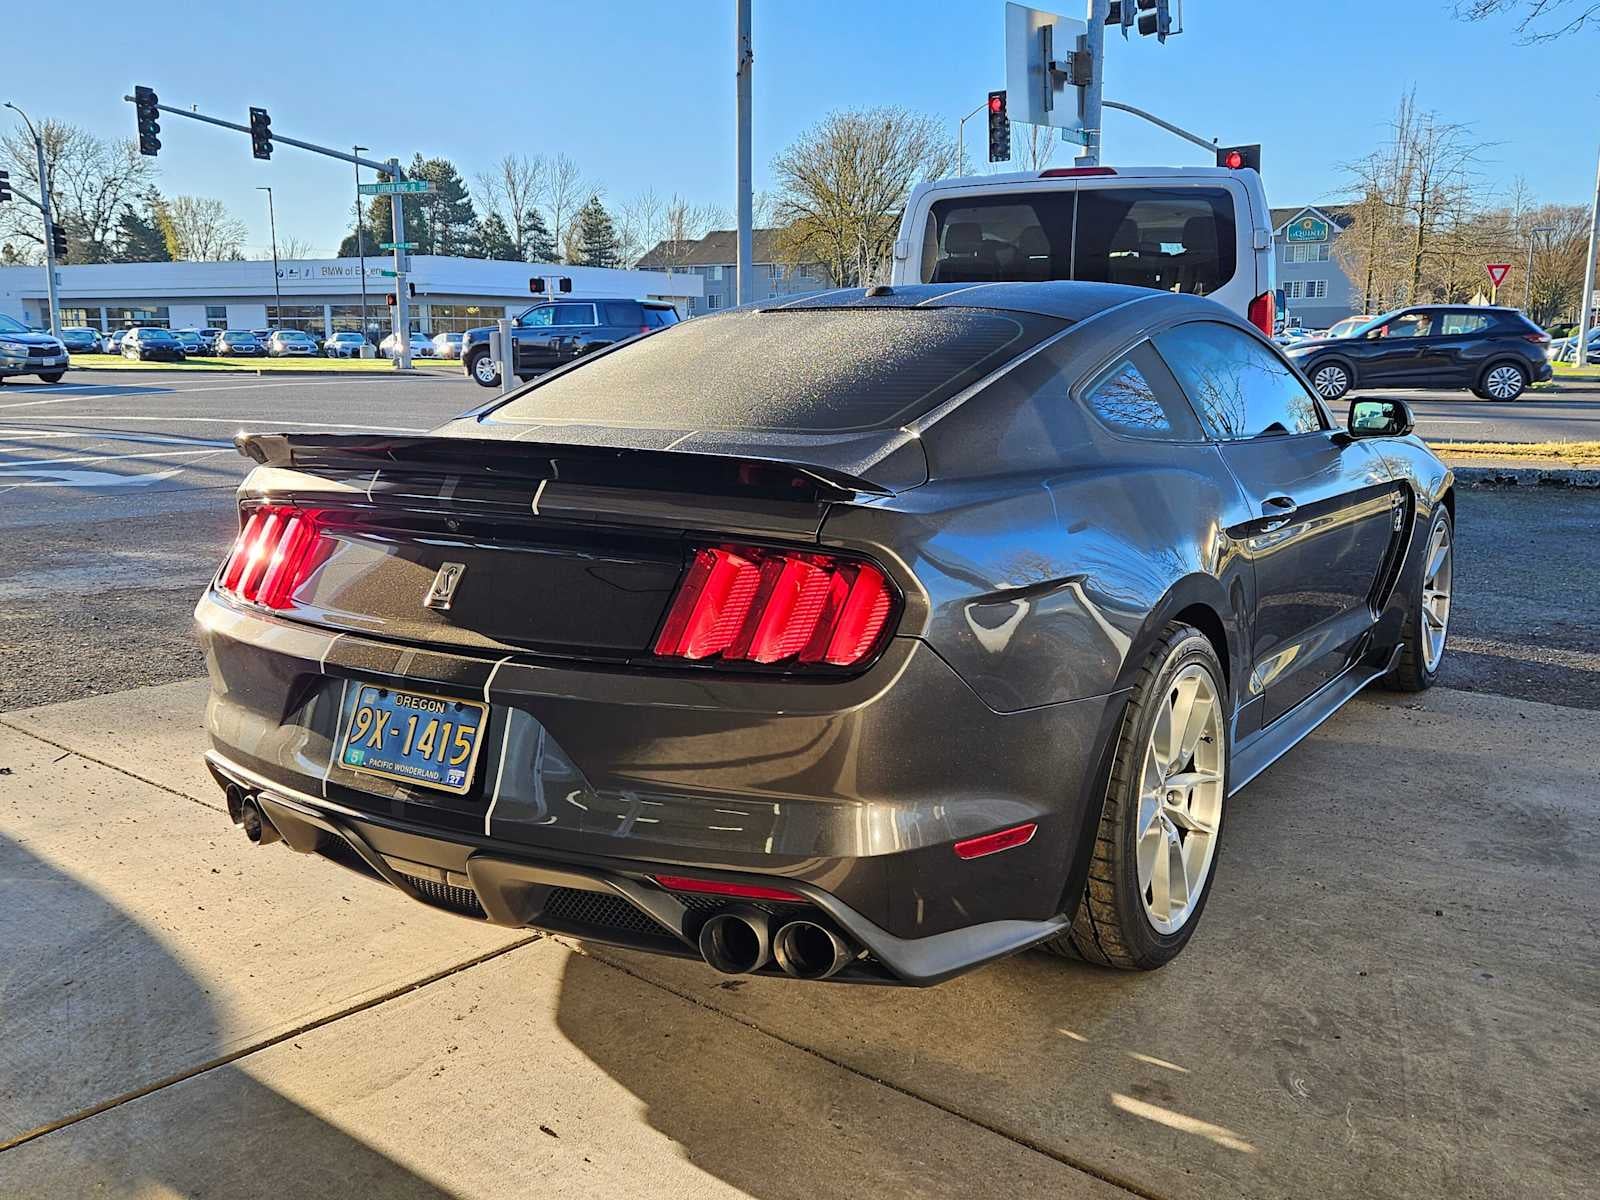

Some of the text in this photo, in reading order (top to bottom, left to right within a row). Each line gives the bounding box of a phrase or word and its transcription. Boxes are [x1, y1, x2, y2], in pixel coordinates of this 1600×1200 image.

[321, 266, 384, 278] BMW of Egen
[394, 694, 446, 714] OREGON
[350, 706, 476, 766] 9X-1415
[368, 758, 440, 780] PACIFIC WONDERLAND
[448, 775, 460, 785] 27
